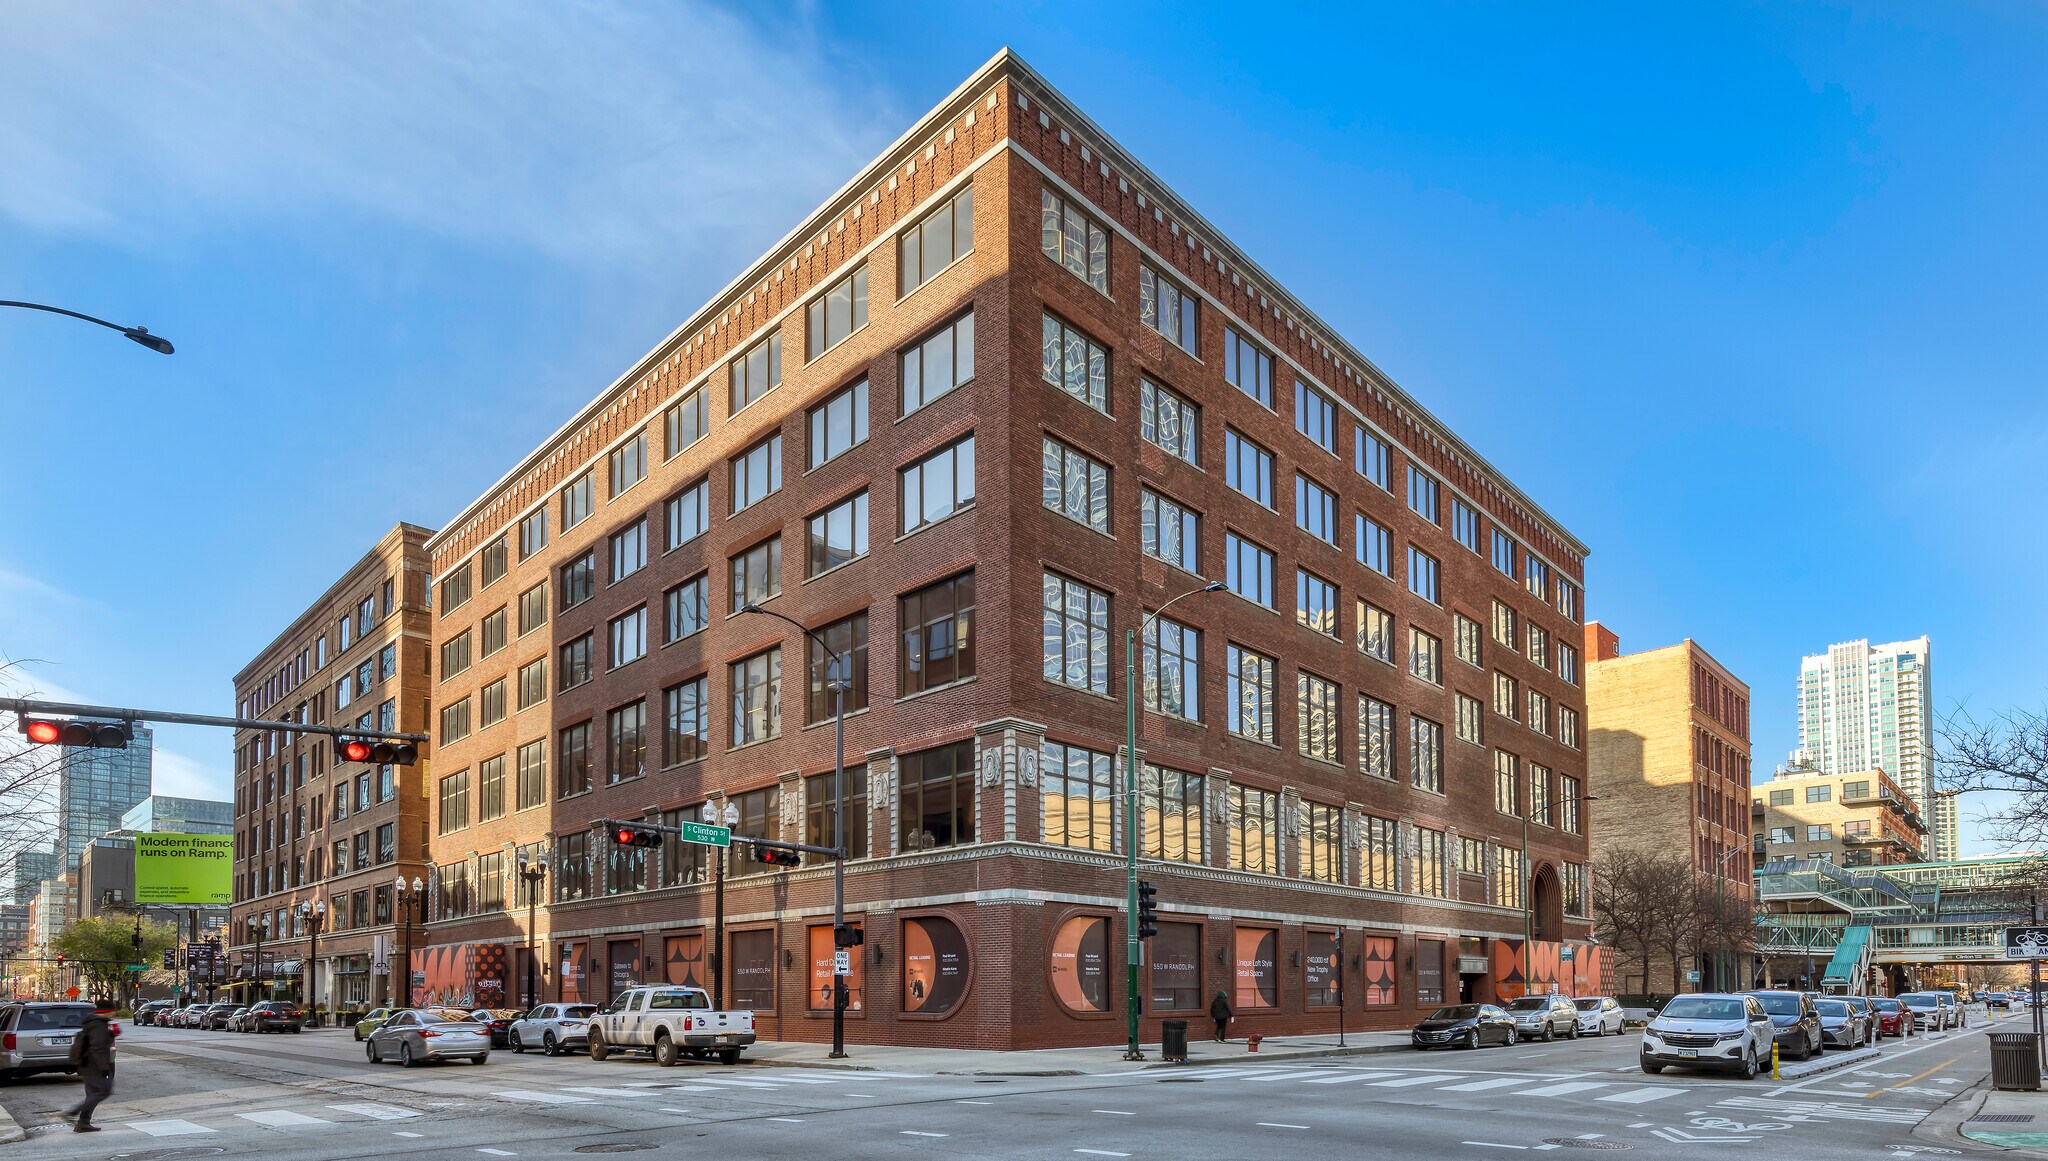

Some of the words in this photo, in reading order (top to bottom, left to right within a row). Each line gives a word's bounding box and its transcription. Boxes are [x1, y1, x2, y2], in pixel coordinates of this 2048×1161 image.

[692, 826, 718, 836] Clinton
[140, 837, 189, 846] Modern
[189, 849, 228, 859] Ramp.
[1262, 960, 1272, 968] Style
